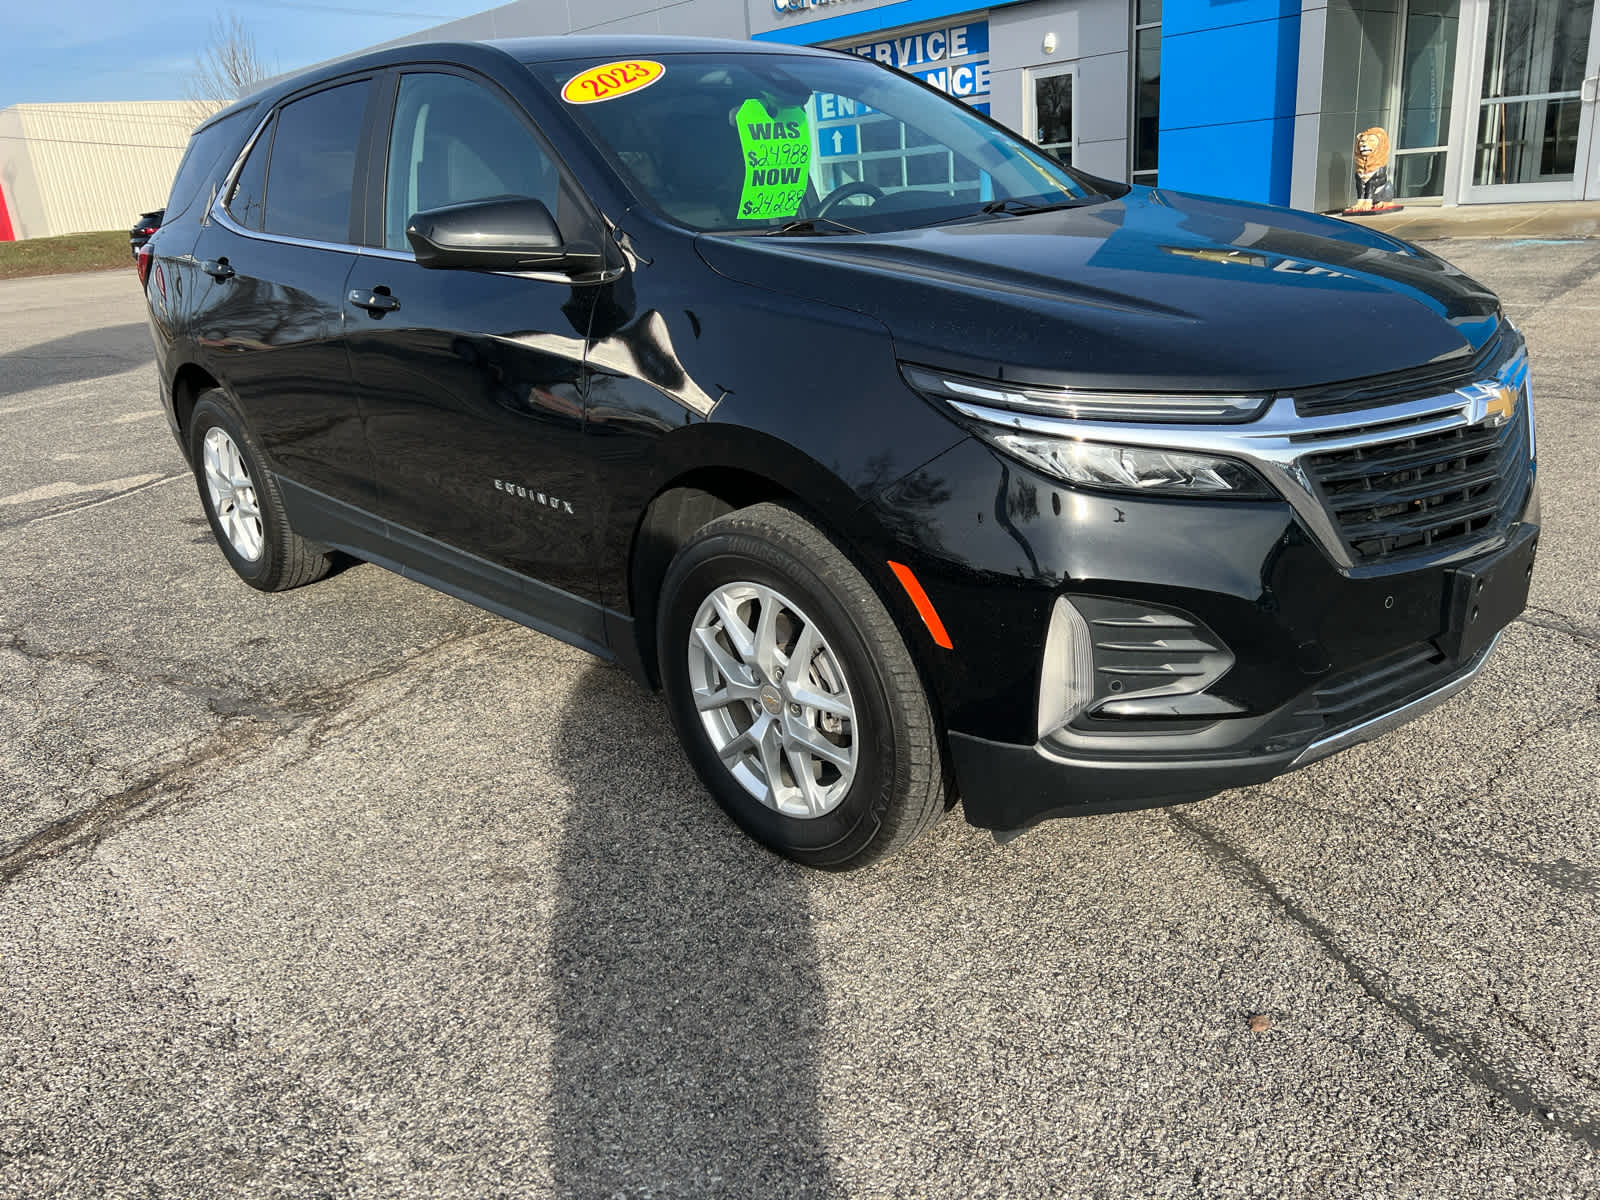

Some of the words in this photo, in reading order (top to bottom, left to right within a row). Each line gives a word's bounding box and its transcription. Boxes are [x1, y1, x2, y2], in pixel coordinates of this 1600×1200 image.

[853, 26, 969, 68] ERVICE
[581, 63, 650, 97] 2023
[747, 121, 800, 140] WAS
[752, 167, 801, 187] NOW
[494, 479, 574, 514] EQUINOX
